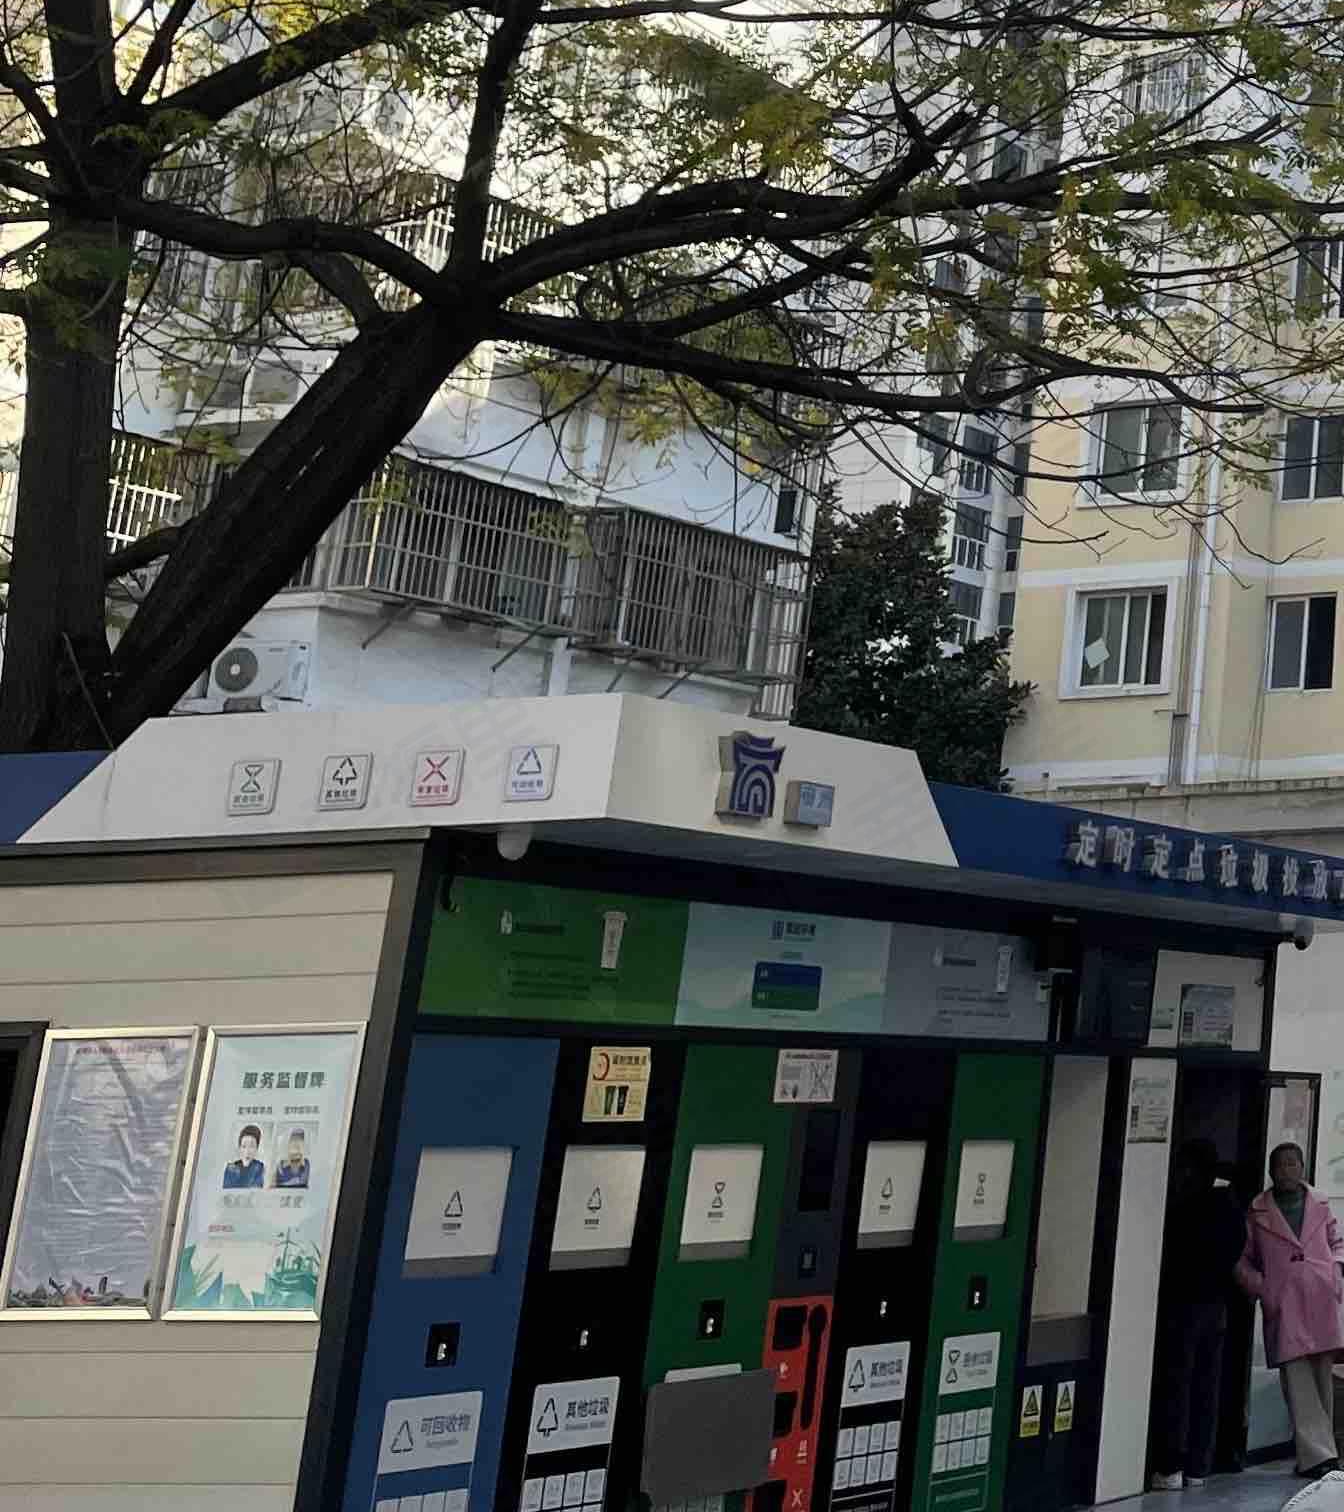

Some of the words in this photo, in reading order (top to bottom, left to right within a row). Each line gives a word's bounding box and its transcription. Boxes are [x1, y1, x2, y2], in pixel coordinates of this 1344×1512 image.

[565, 1396, 610, 1420] 其他垃圾
[420, 1413, 471, 1435] 可回收物
